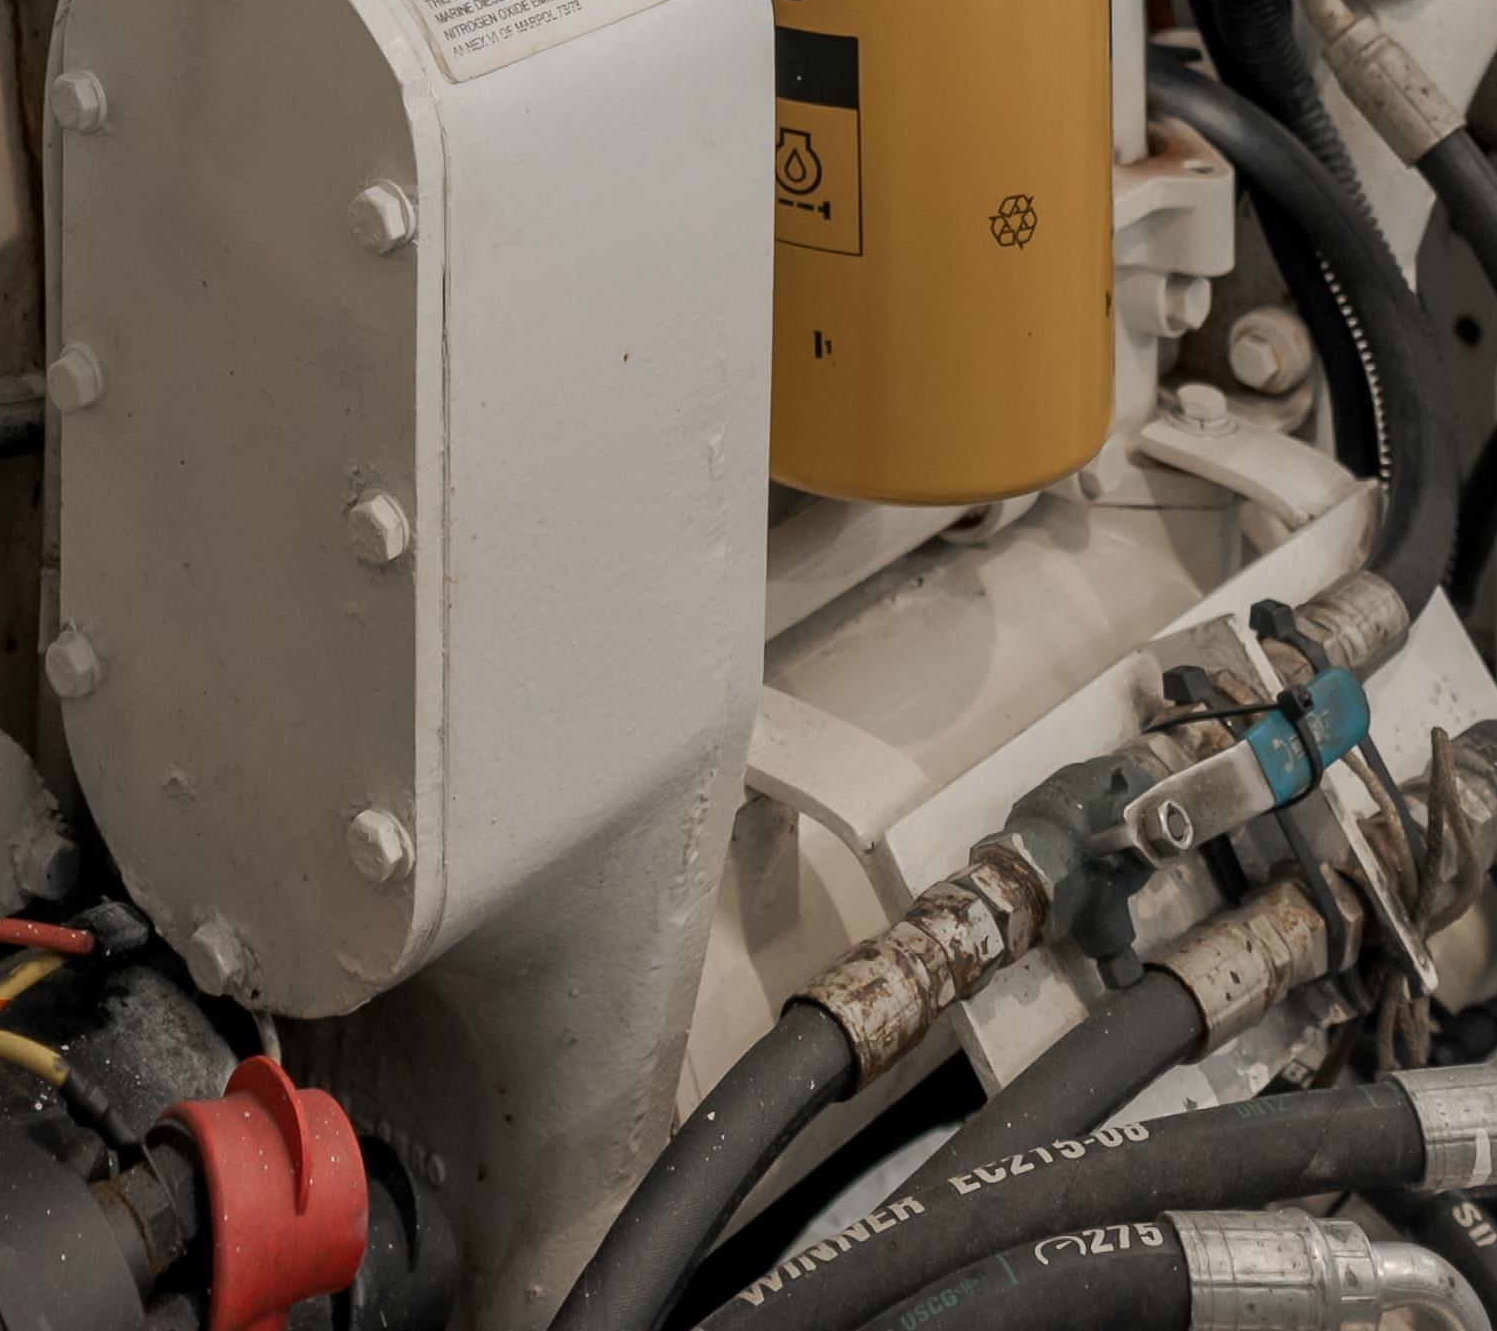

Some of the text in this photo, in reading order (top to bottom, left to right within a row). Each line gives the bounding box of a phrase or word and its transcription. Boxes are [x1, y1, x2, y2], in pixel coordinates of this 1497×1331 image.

[434, 5, 473, 26] MARINE
[443, 13, 498, 40] NITROGEN
[497, 0, 530, 21] OXIDE
[452, 38, 487, 58] ANNEX
[488, 32, 499, 46] VI
[499, 25, 513, 40] OF
[514, 10, 557, 35] MARPOL
[1086, 1221, 1165, 1256] 275
